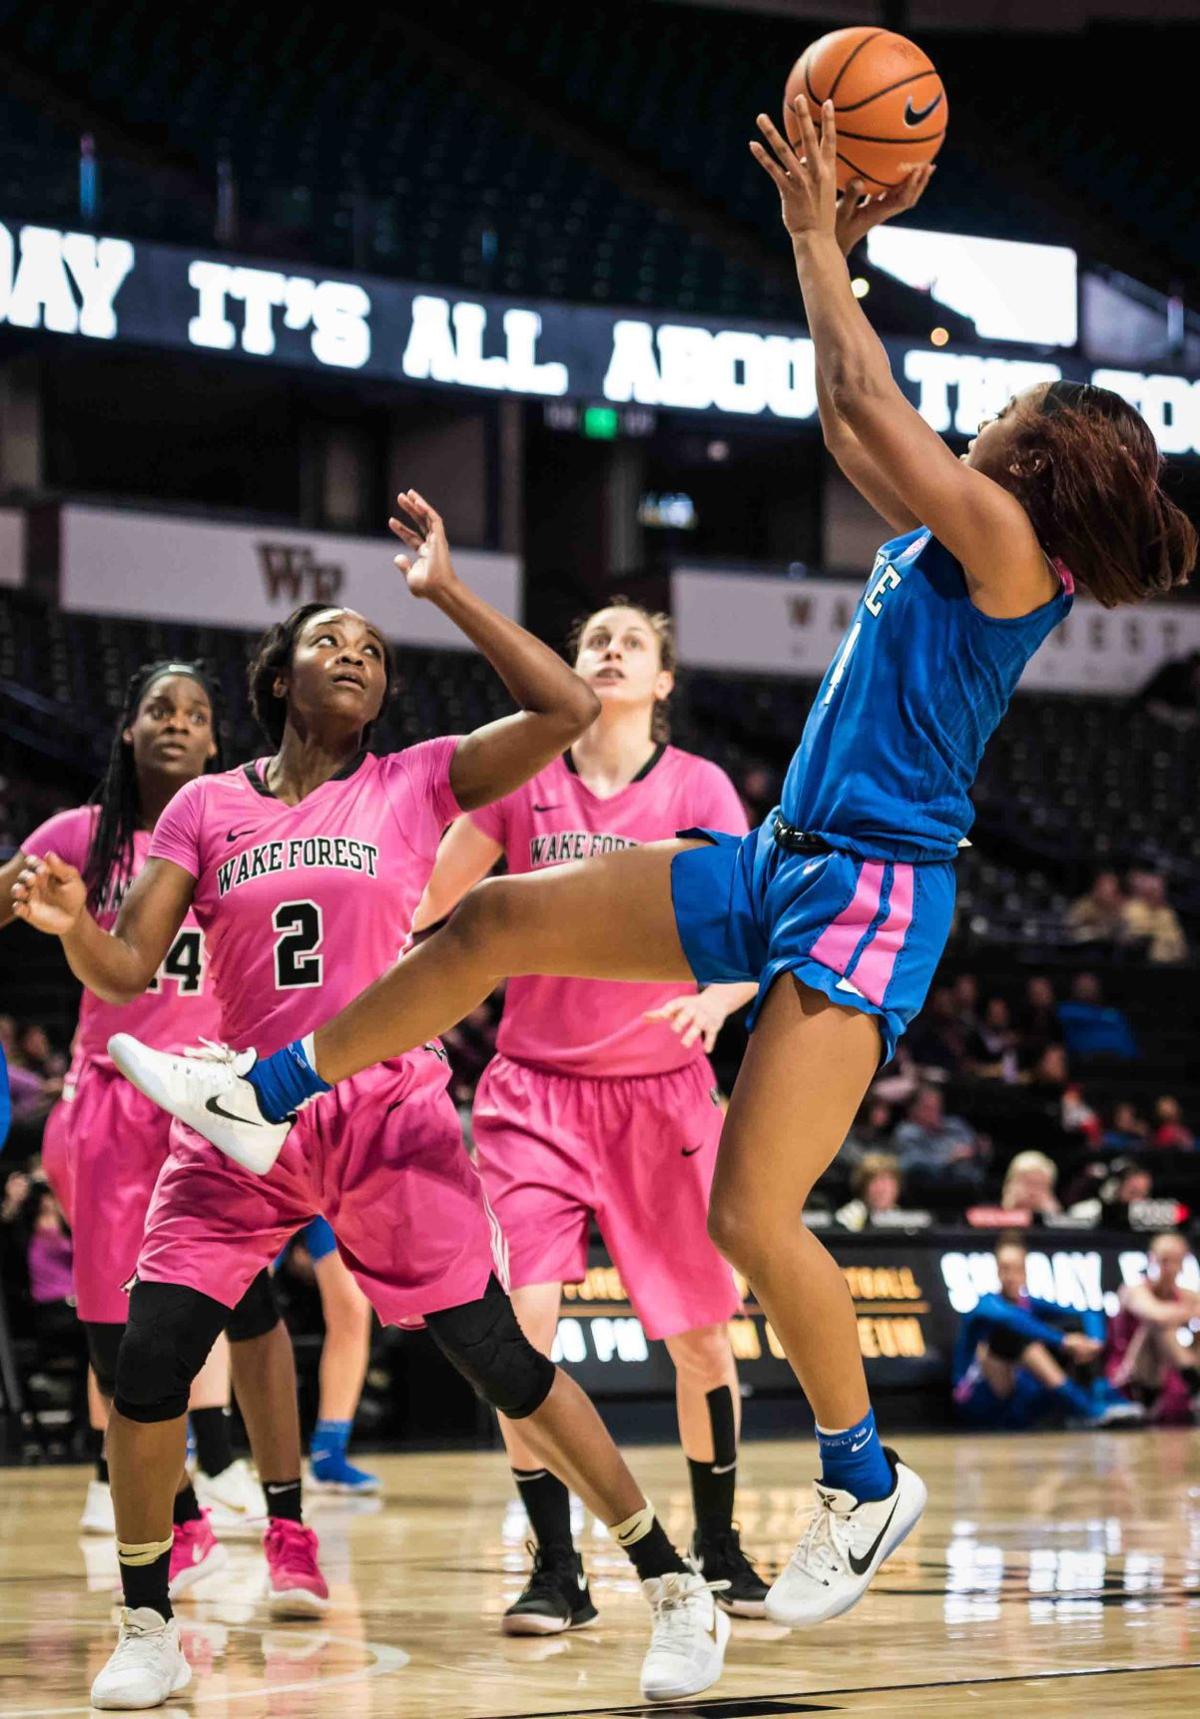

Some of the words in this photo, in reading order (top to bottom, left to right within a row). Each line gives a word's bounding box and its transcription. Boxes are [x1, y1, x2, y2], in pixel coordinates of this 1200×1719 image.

[188, 261, 370, 369] IT'S
[403, 295, 568, 396] ALL
[603, 319, 817, 420] ABOU
[216, 838, 285, 899] WAKE
[287, 835, 379, 879] FOREST
[529, 831, 587, 867] WAKE
[145, 926, 207, 997] 4
[271, 899, 324, 990] 2
